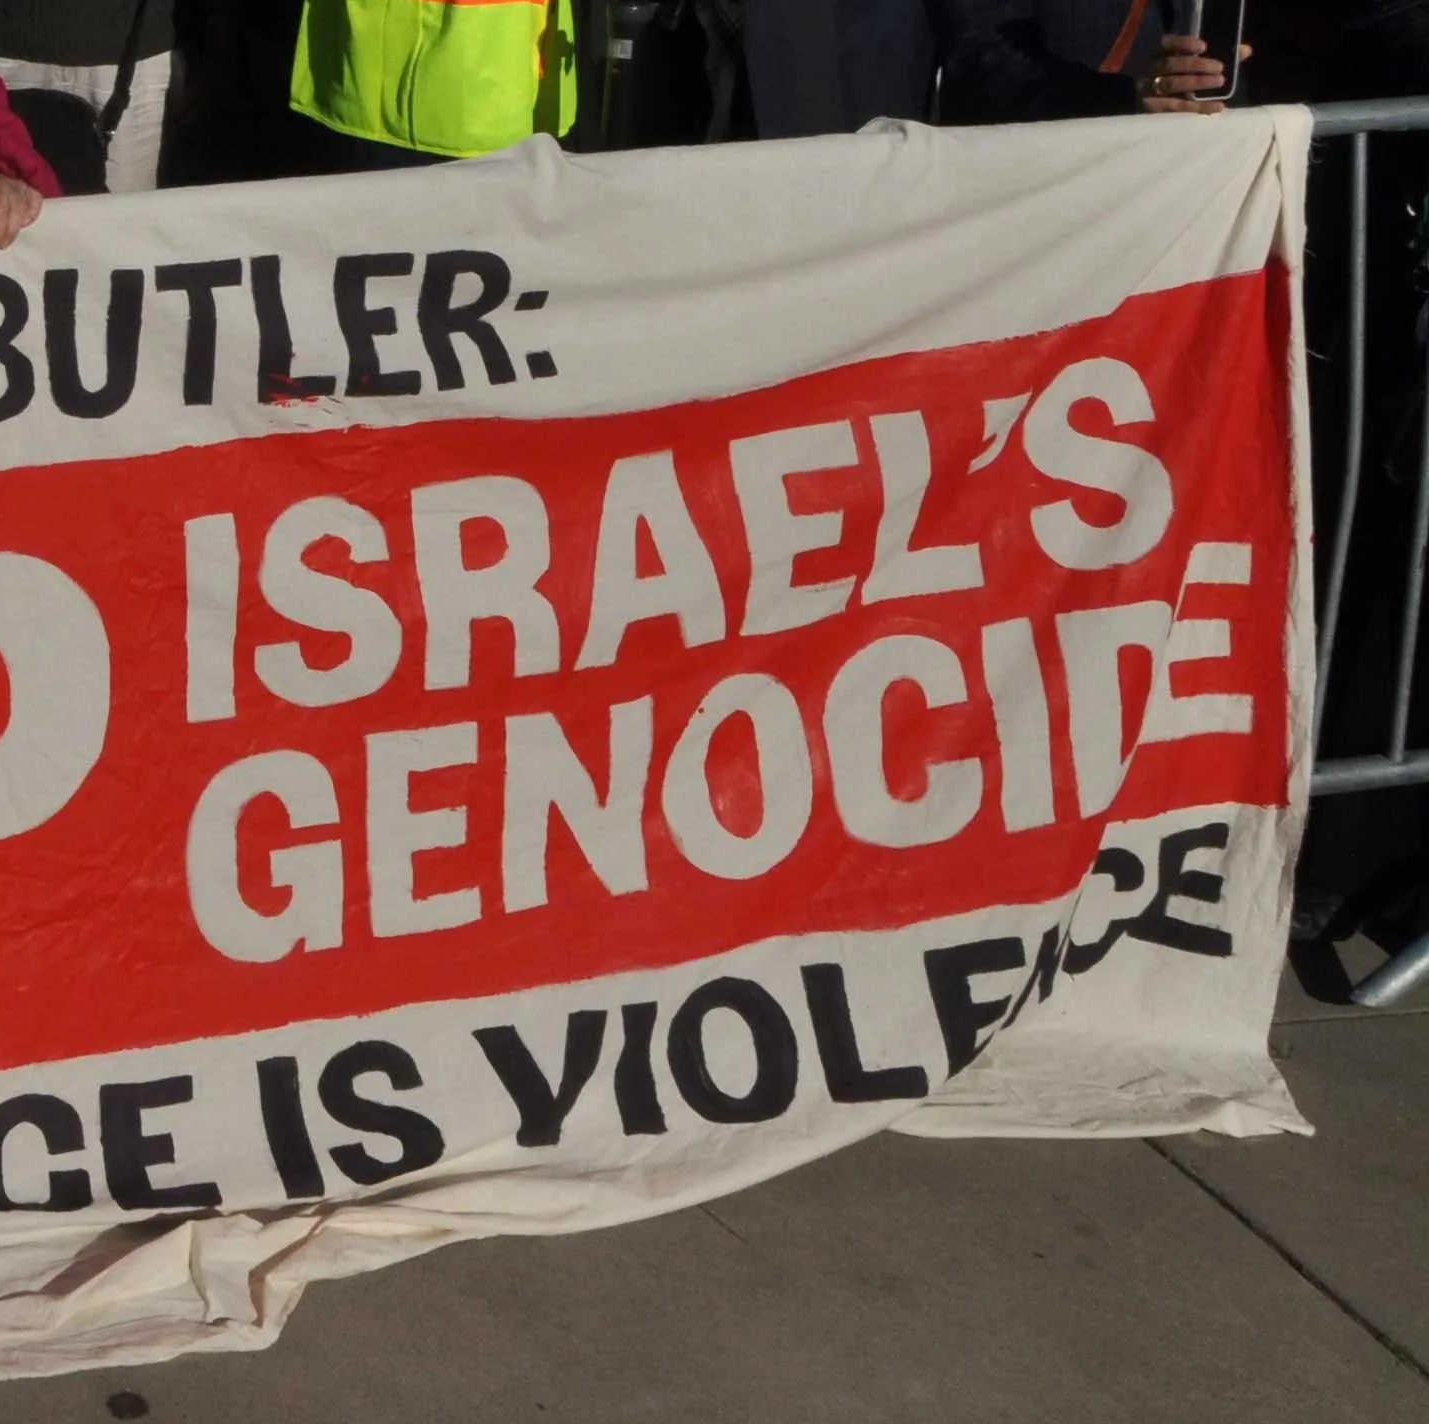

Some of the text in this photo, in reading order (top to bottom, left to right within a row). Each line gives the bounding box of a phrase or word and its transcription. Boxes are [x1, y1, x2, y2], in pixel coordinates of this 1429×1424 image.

[183, 355, 1176, 725] ISRAEL'S
[183, 542, 1255, 966] GENOCIDE
[257, 1038, 444, 1199] IS
